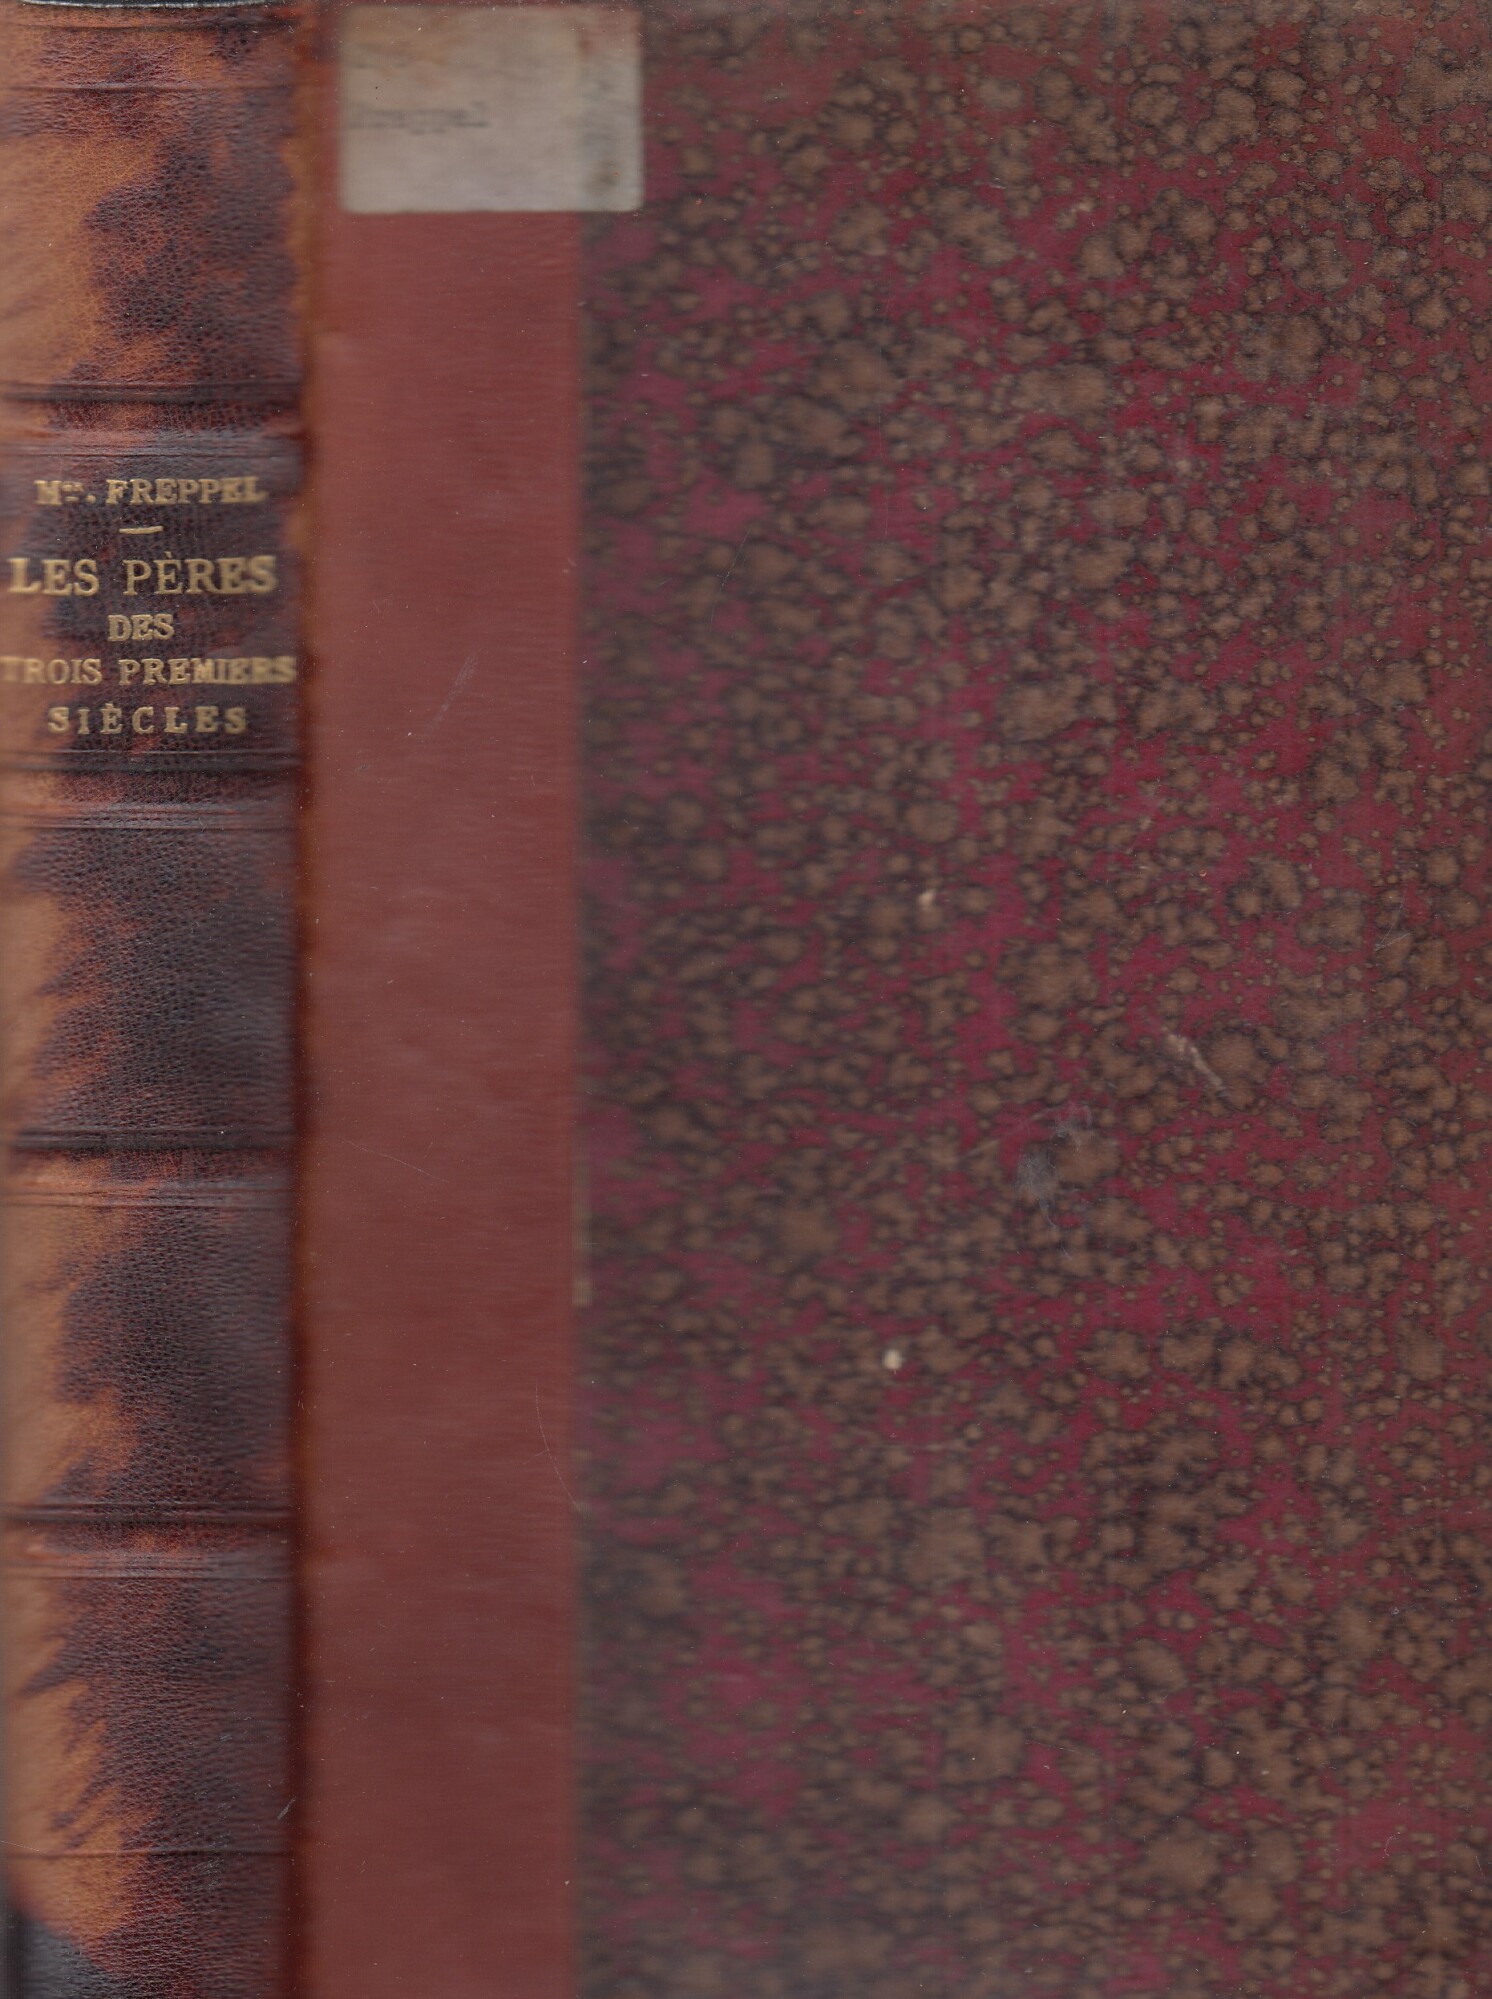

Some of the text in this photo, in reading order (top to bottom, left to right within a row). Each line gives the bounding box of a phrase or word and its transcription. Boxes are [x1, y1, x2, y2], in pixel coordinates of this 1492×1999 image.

[105, 476, 269, 505] FREPPEL
[7, 551, 279, 596] LES PÈRES
[107, 613, 175, 642] DES
[0, 655, 298, 686] TROIS PREMIERS
[48, 702, 249, 735] SIÈCLES
